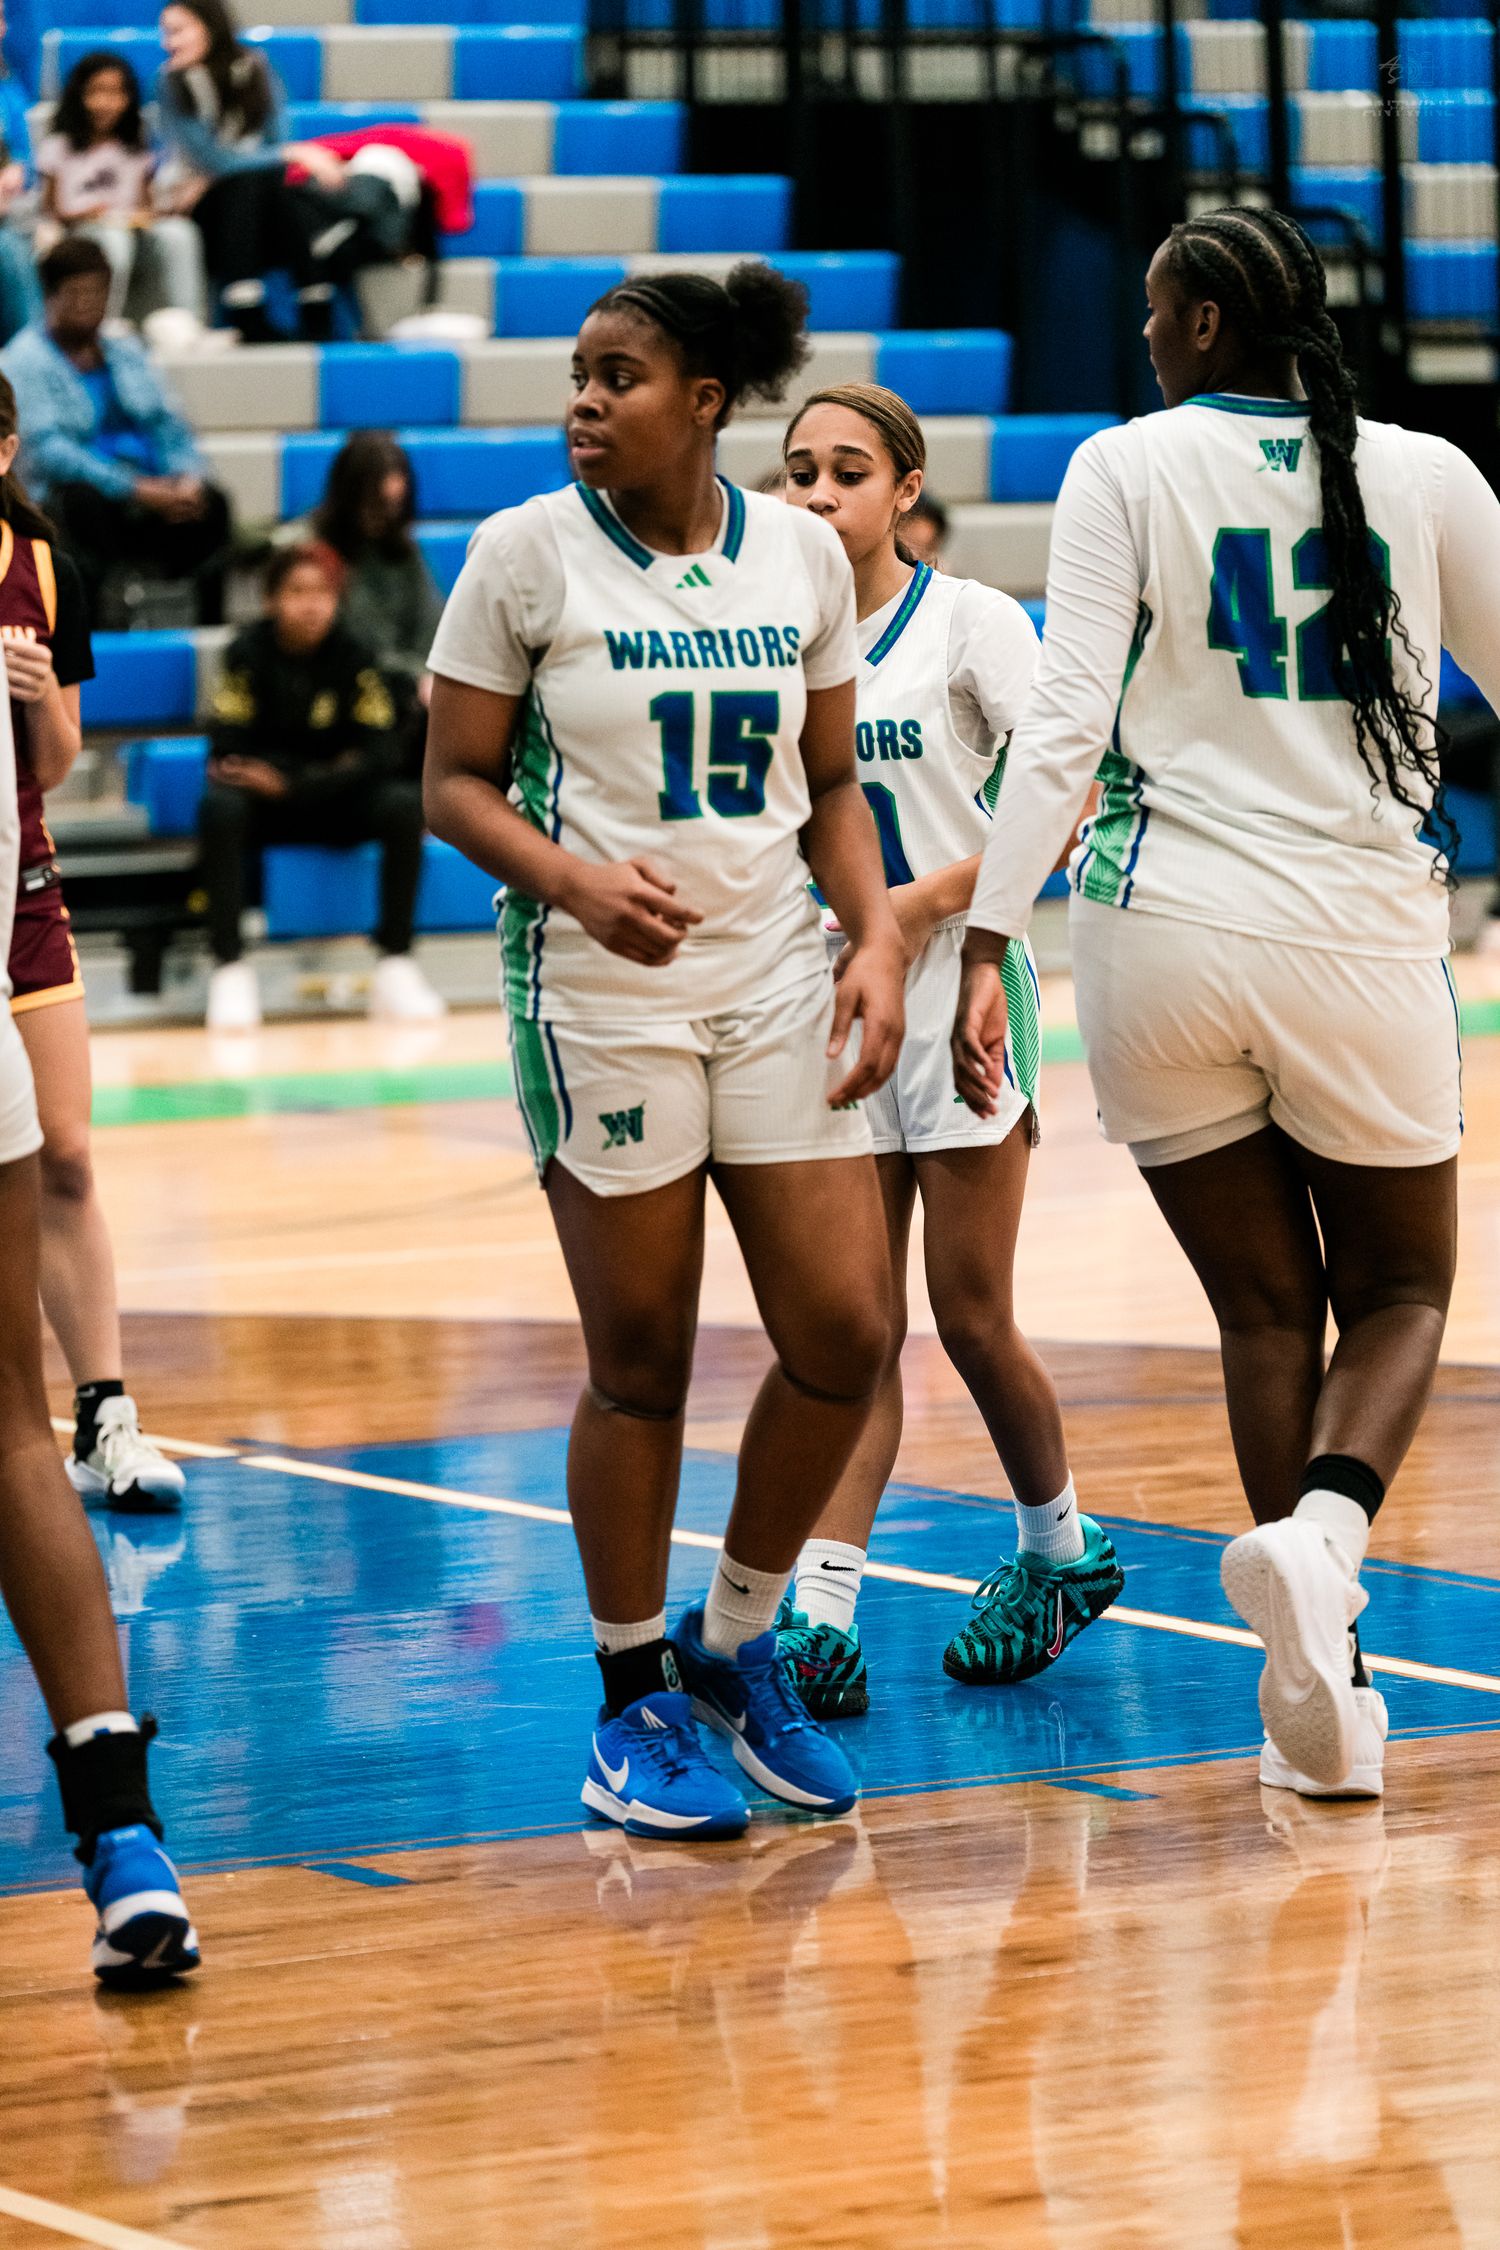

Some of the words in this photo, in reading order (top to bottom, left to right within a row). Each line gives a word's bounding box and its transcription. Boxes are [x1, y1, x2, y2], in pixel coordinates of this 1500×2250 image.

[1258, 438, 1304, 473] W
[604, 626, 801, 670] WARRIORS
[1206, 527, 1393, 702] 42
[649, 691, 780, 821] 15
